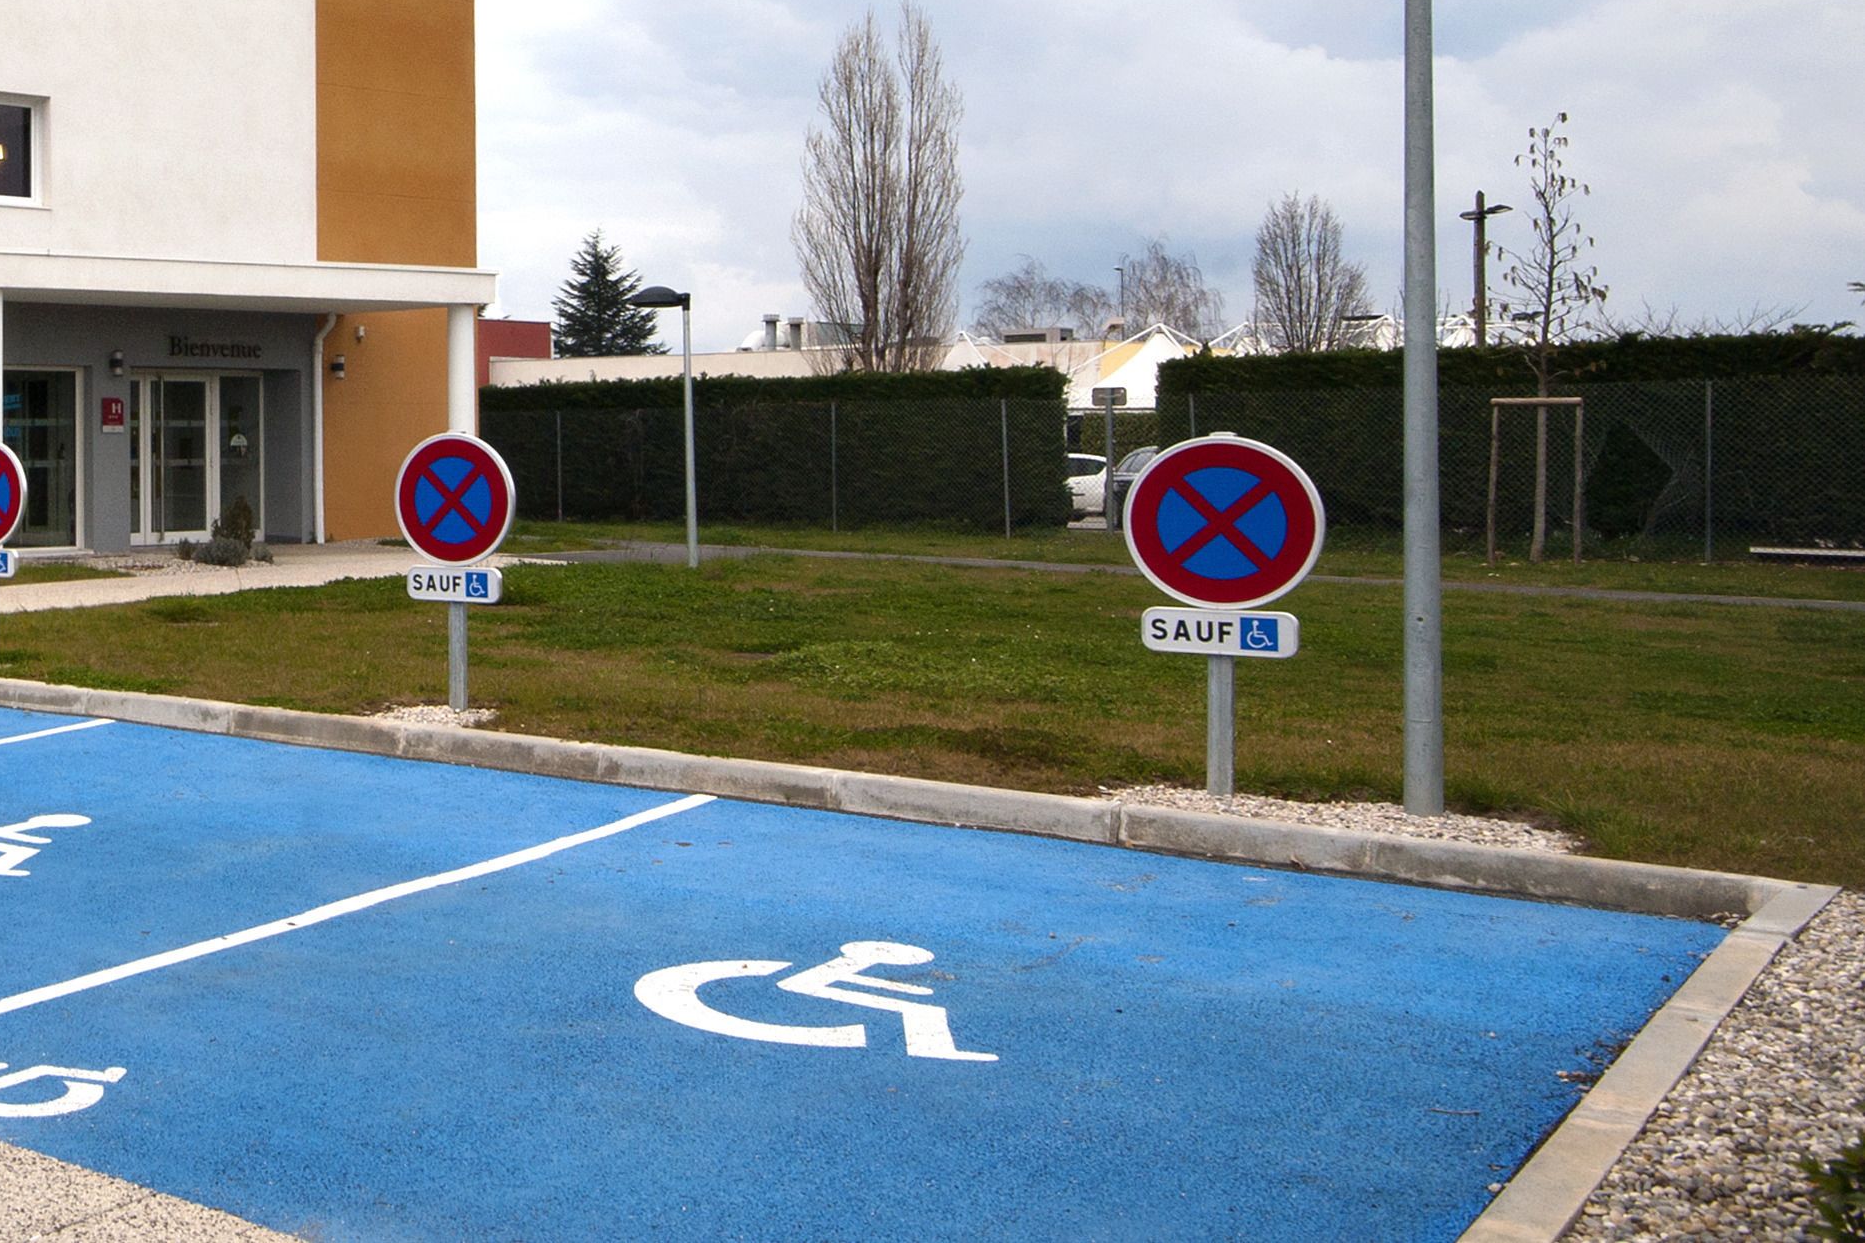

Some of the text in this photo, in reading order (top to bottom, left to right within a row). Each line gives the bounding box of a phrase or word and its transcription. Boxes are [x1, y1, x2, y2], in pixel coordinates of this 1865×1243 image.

[168, 335, 262, 358] Bienvenue
[111, 403, 122, 414] H
[412, 573, 462, 593] SAUF
[1151, 618, 1234, 644] SAUF
